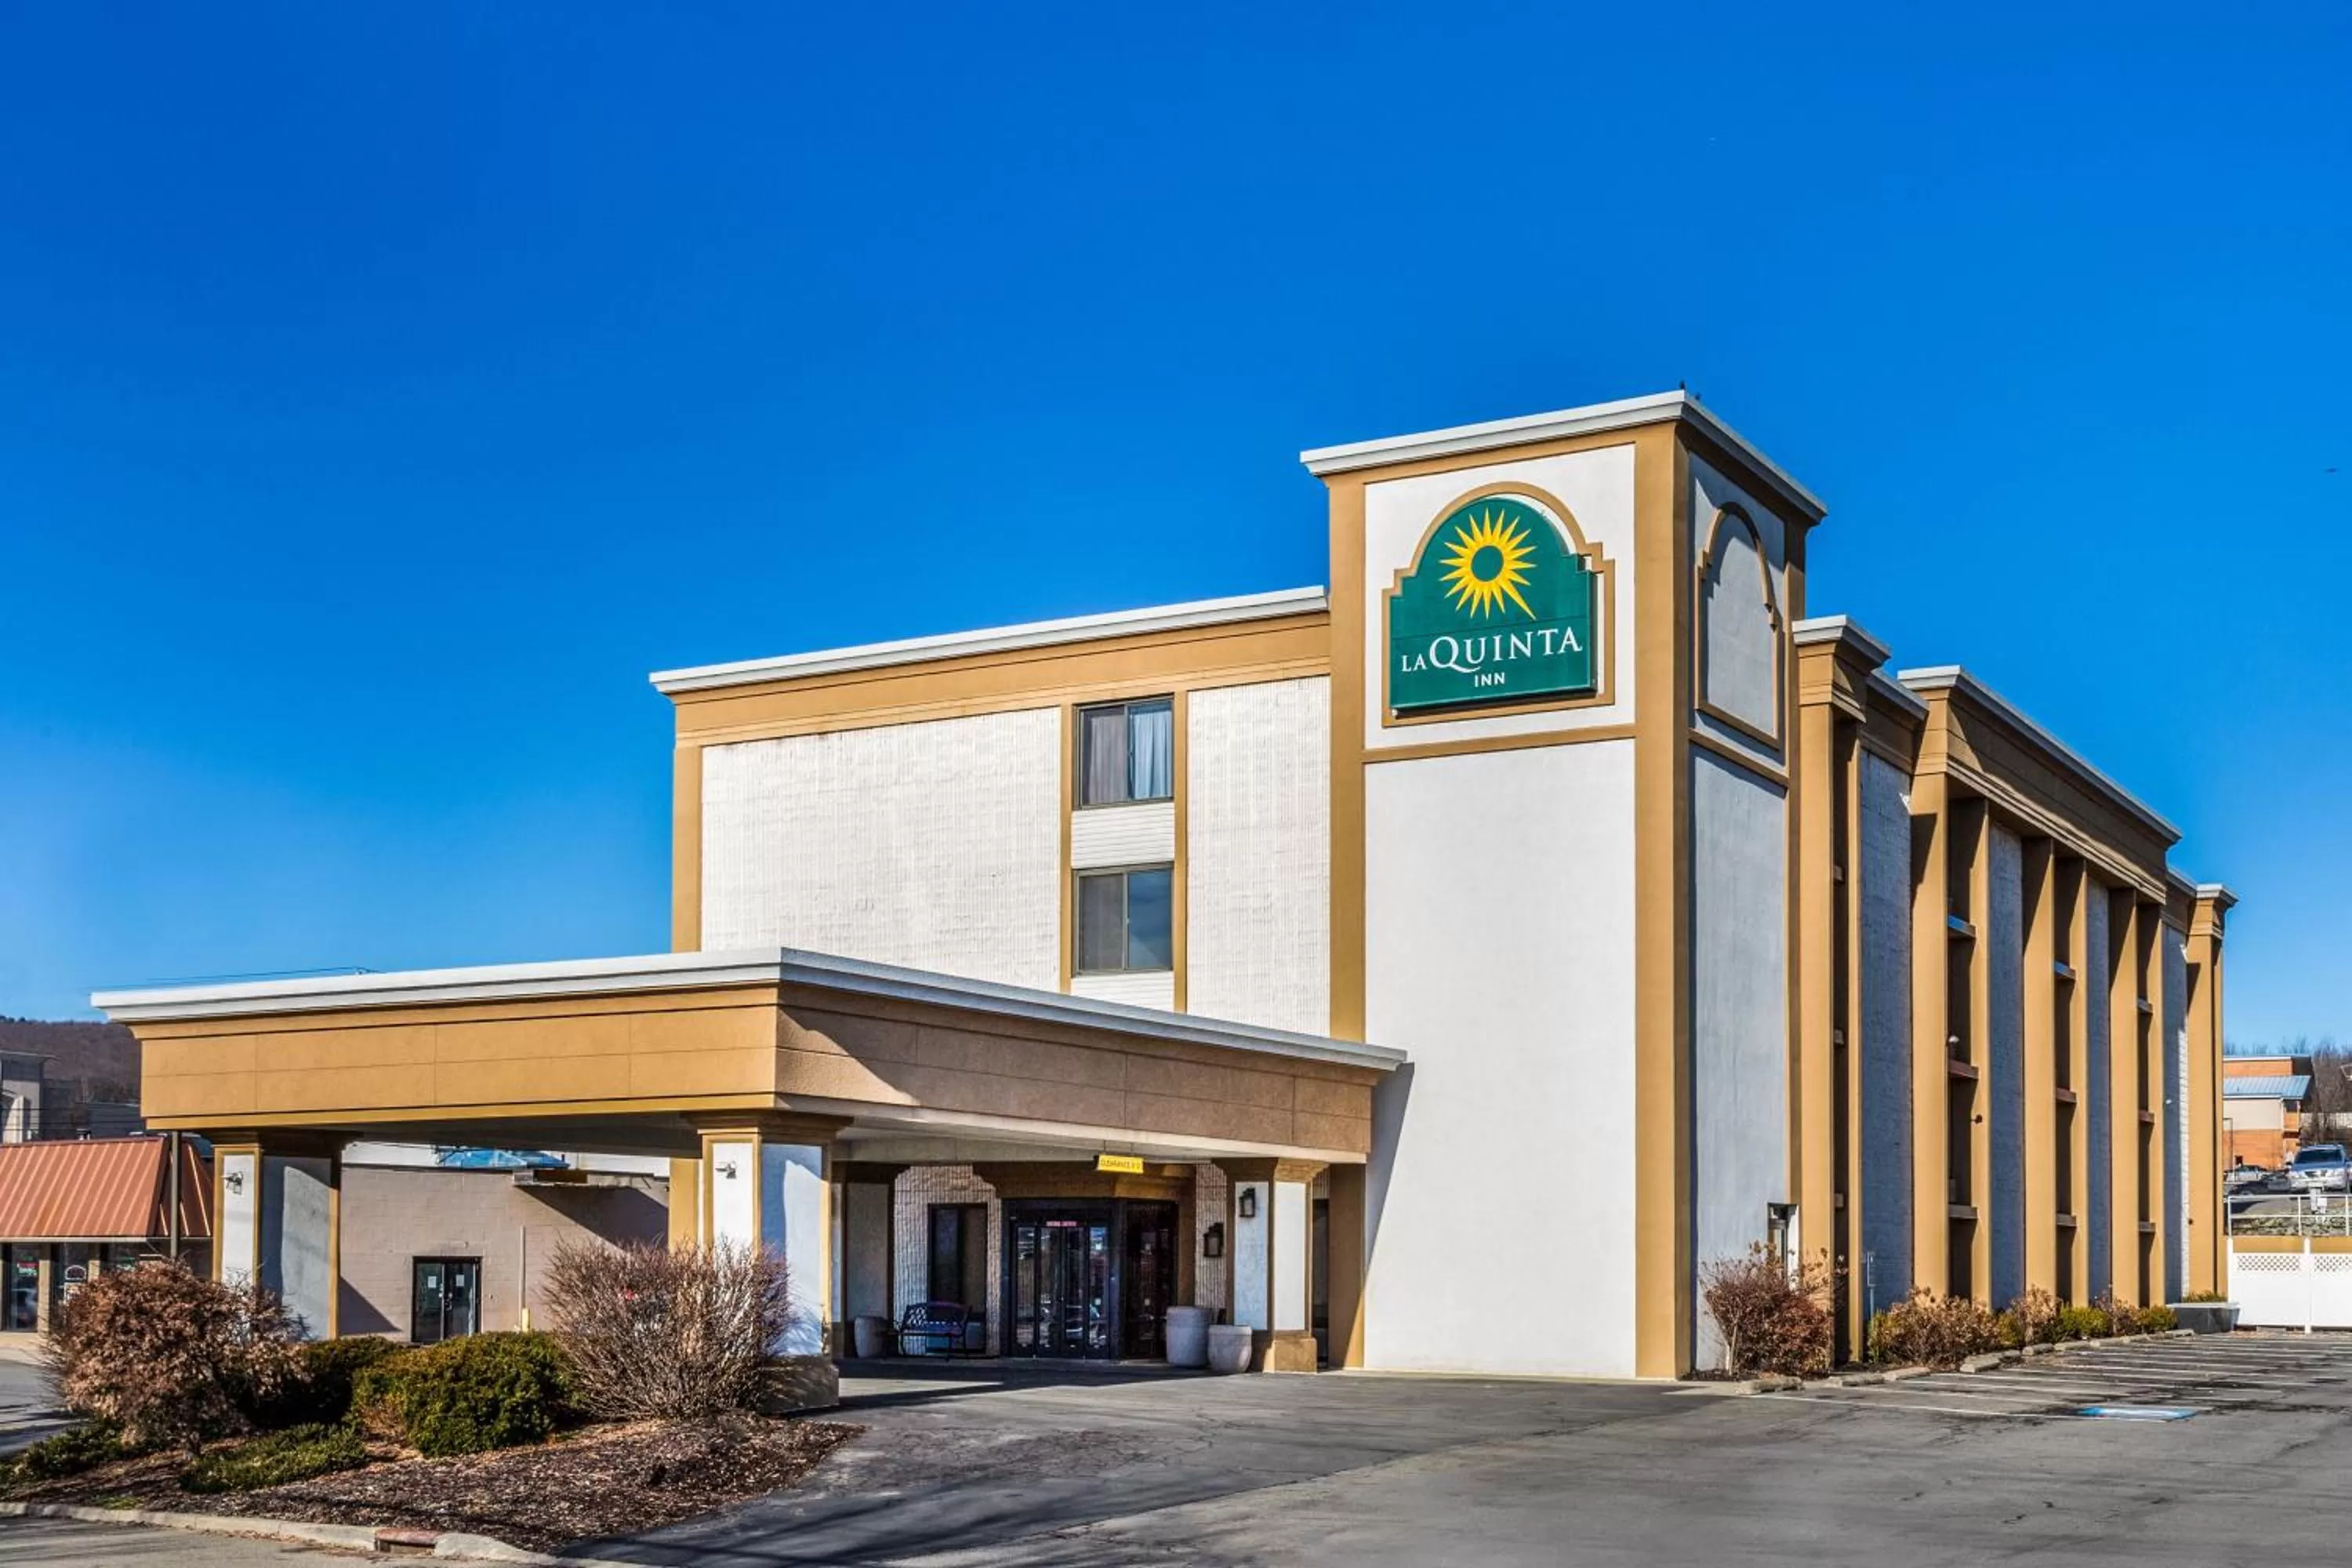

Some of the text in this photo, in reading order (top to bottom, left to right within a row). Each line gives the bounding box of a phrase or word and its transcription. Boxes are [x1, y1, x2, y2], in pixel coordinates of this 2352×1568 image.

[1402, 626, 1583, 673] LA QUINTA
[1474, 673, 1505, 688] INN
